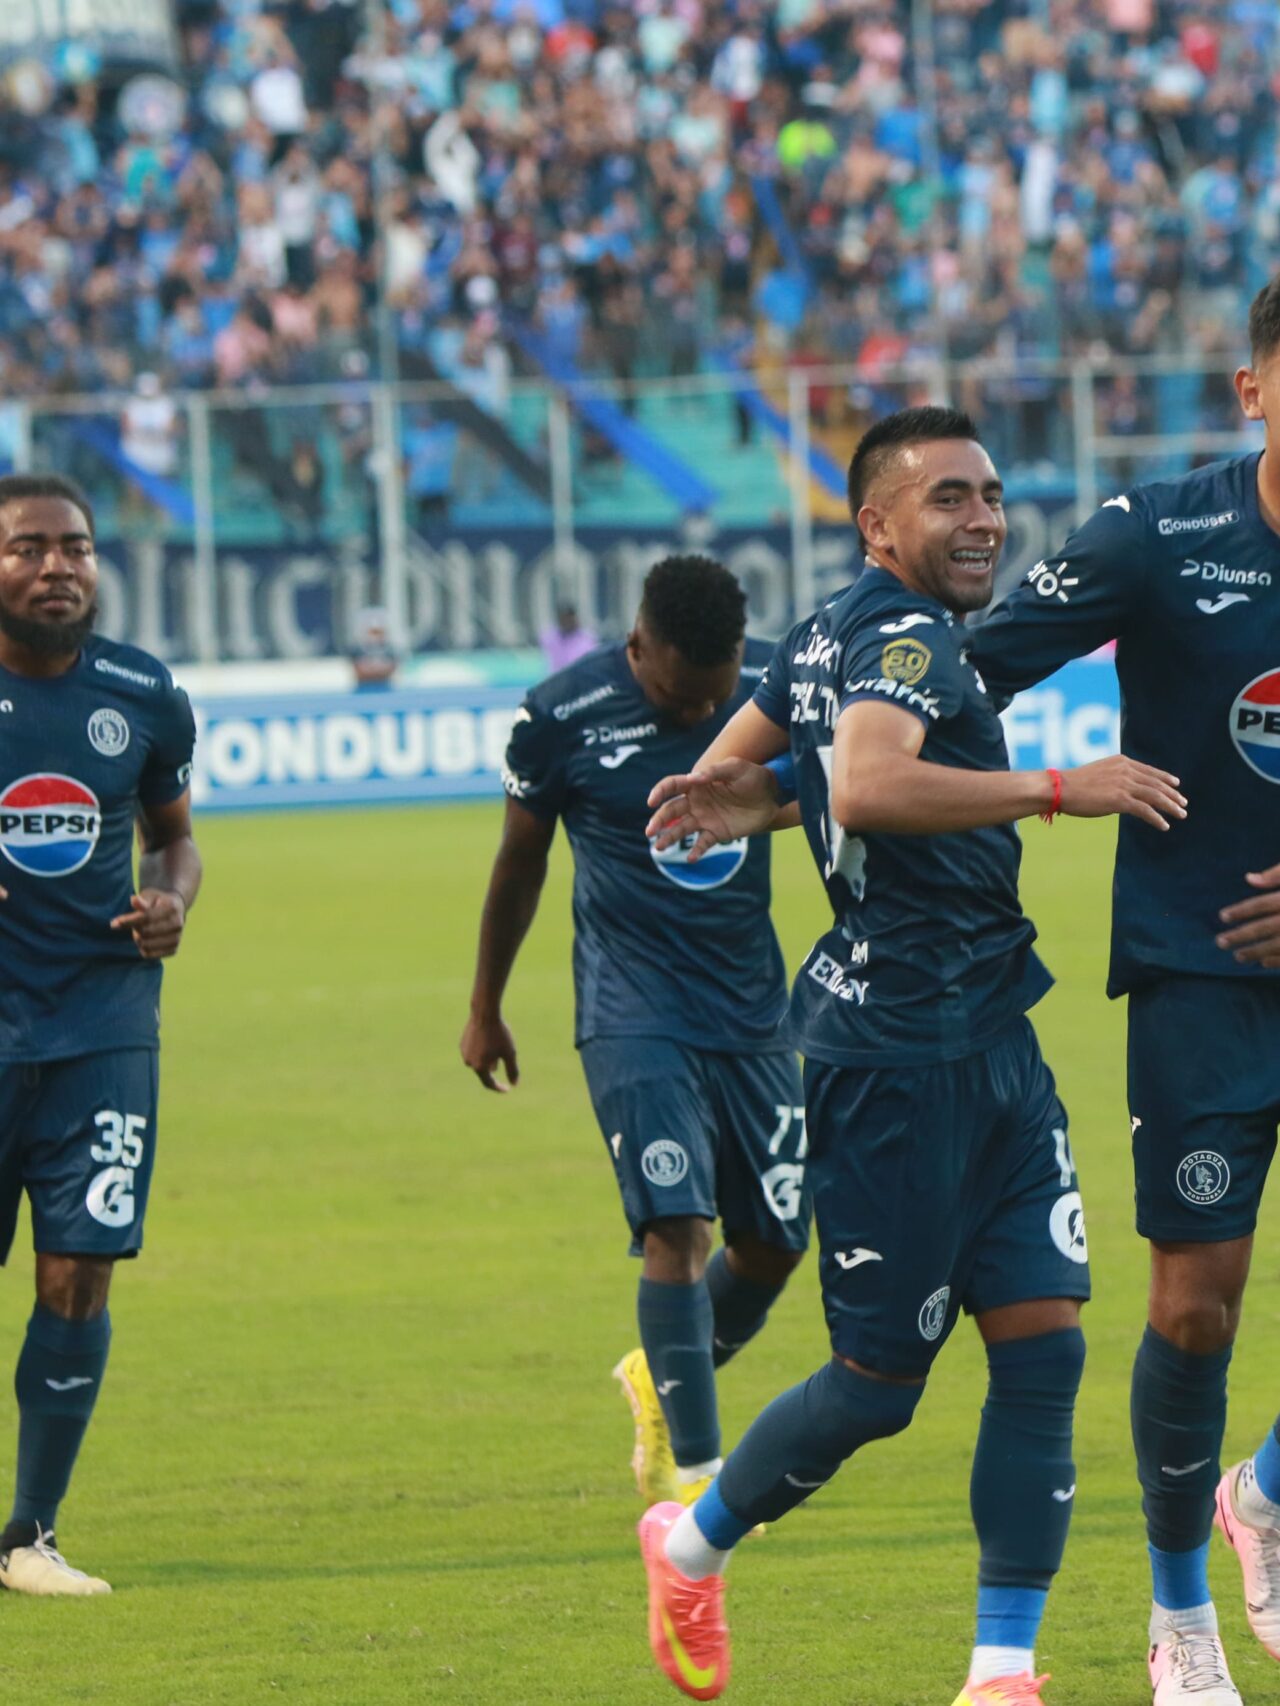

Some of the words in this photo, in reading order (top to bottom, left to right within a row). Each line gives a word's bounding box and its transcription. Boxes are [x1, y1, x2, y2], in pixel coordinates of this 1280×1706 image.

[1158, 511, 1234, 535] HONDUBET
[1201, 561, 1272, 586] Diunsa
[599, 723, 658, 743] Diunsa
[0, 814, 96, 835] PEPSI
[90, 1109, 148, 1168] 35
[768, 1104, 808, 1159] 77
[1182, 1153, 1223, 1171] MOTAGUA
